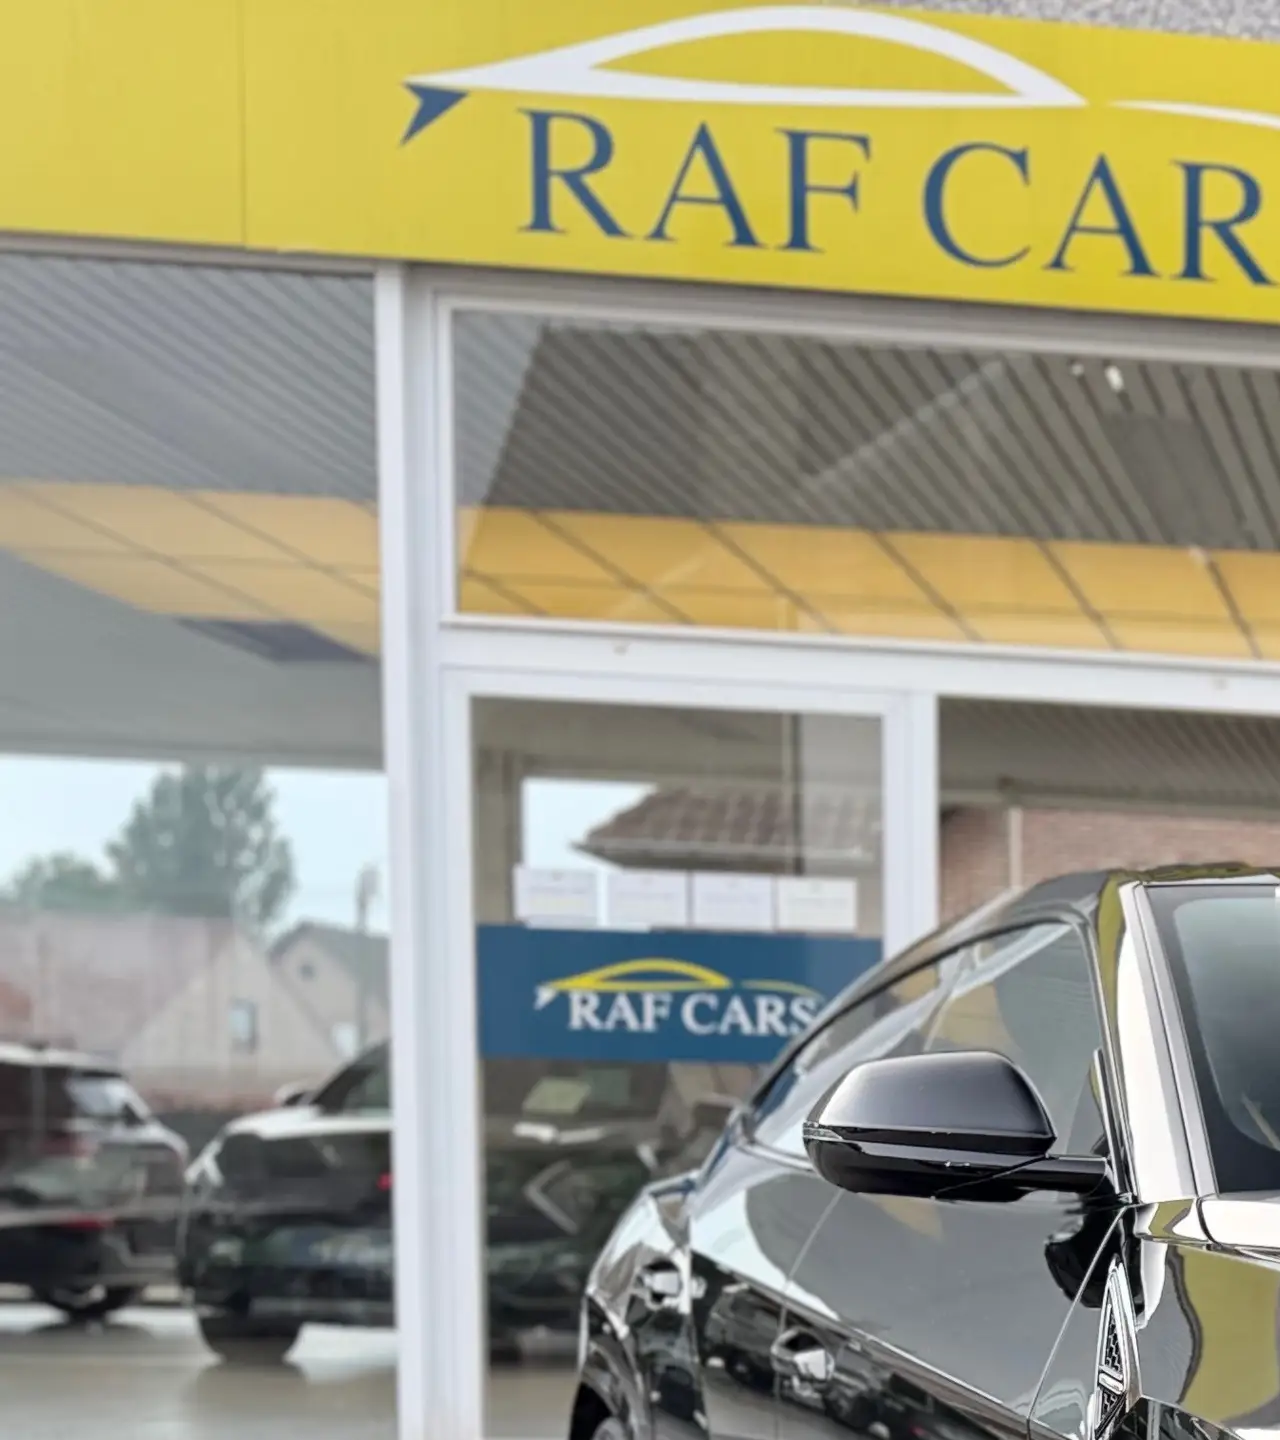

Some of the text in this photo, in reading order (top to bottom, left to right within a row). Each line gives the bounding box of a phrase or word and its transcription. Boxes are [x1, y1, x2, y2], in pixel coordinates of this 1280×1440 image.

[516, 107, 871, 253] RAF
[569, 991, 818, 1037] RAF CARS
